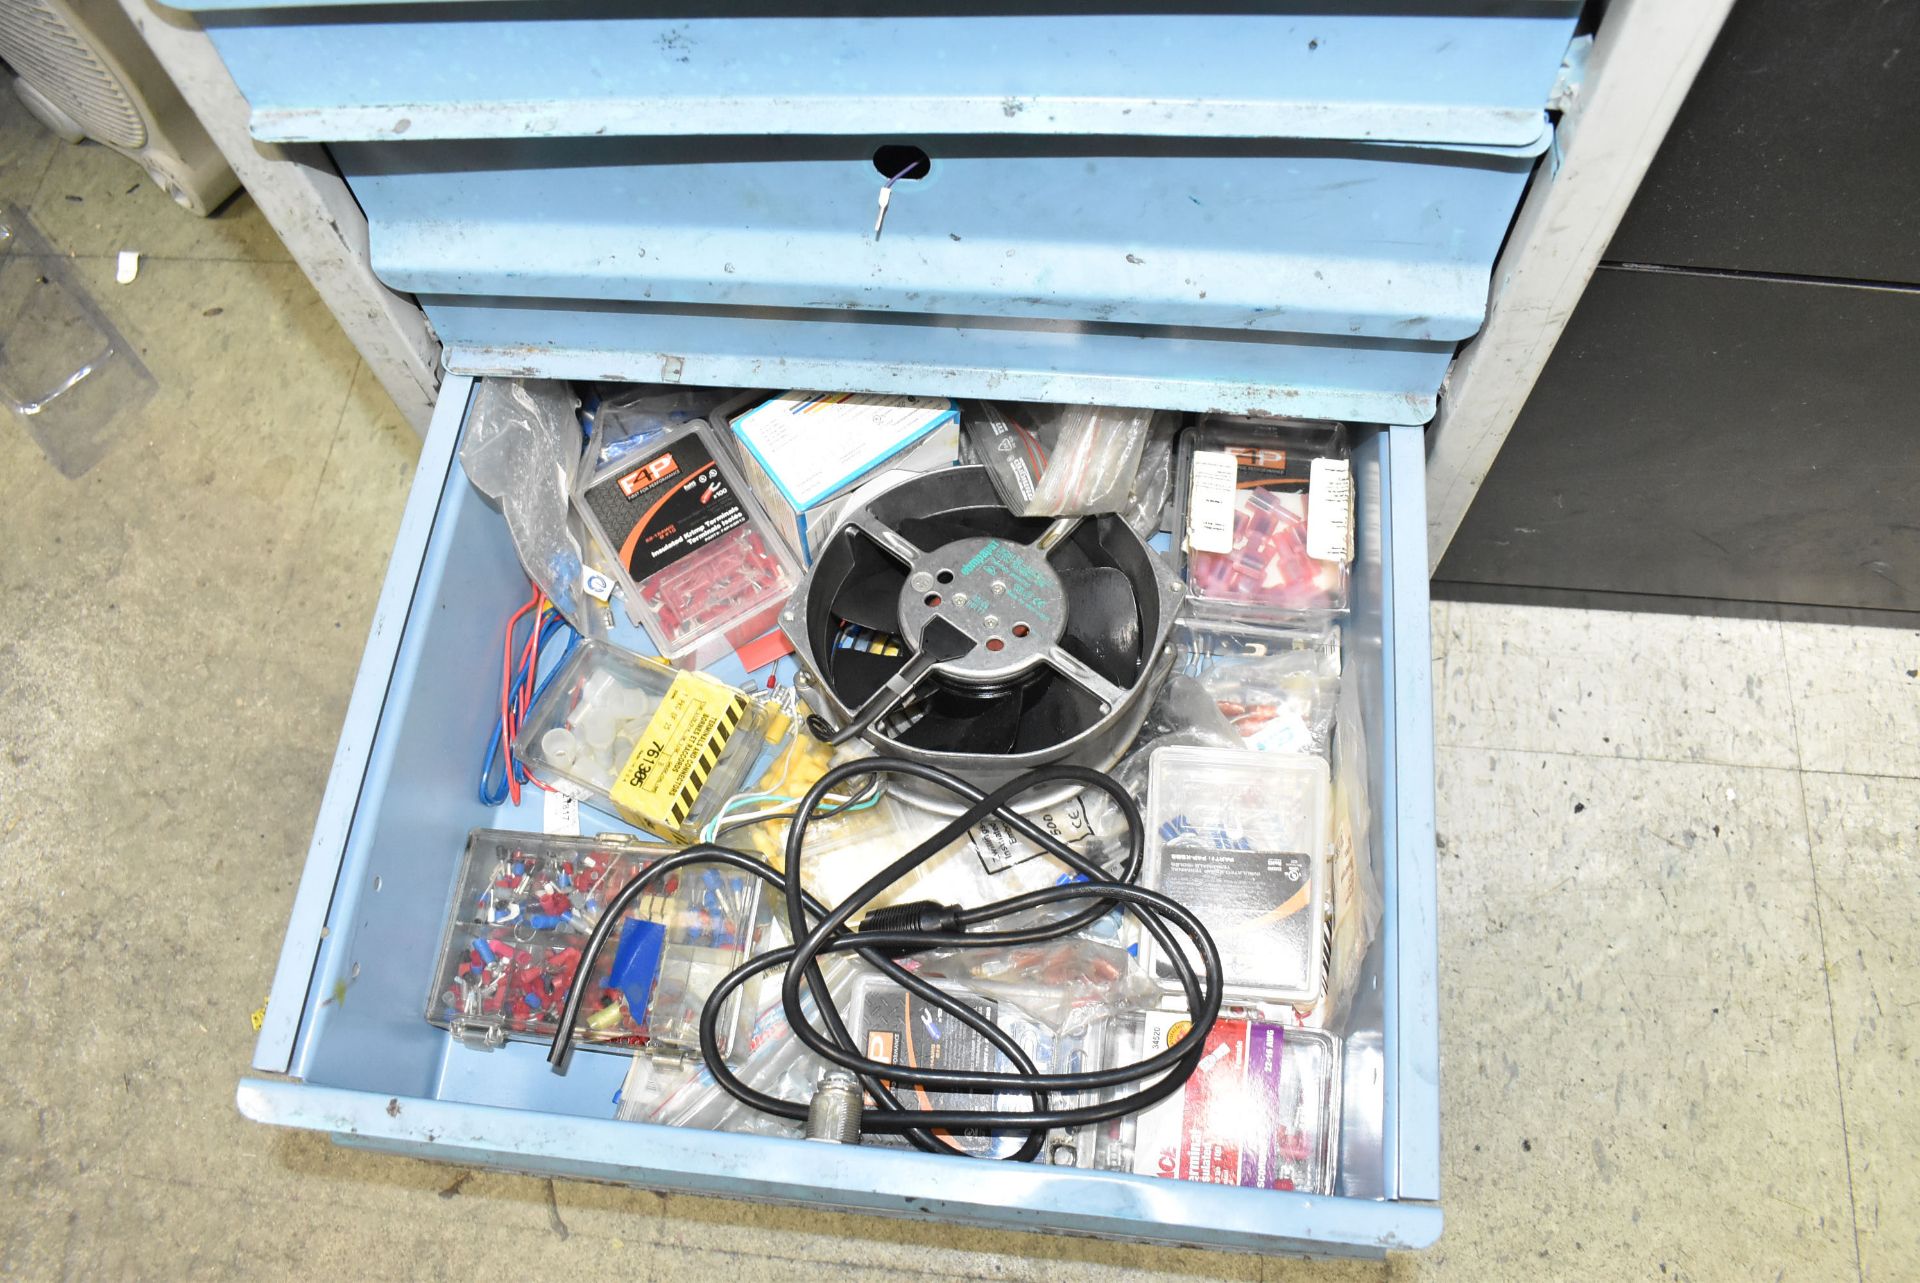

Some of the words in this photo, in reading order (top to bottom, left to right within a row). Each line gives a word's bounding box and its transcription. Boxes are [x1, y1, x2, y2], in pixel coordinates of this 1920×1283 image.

[620, 454, 672, 494] F4P
[627, 491, 640, 501] FIRST
[648, 469, 681, 488] PERFORMANCE
[651, 535, 684, 558] Insulated
[683, 524, 706, 540] Krimp
[704, 505, 740, 527] Terminals
[686, 523, 722, 545] Terminals
[960, 538, 1001, 577] ebmpapst
[689, 735, 697, 744] ET
[696, 716, 717, 747] TERMINALS
[689, 747, 700, 760] AND
[668, 758, 694, 797] CONNECTORS
[1043, 814, 1061, 836] 500
[1068, 809, 1082, 829] CE
[1151, 1026, 1162, 1050] 34520
[1265, 1029, 1274, 1047] AWG
[1188, 1129, 1203, 1182] erminal
[1201, 1141, 1211, 1183] sulated
